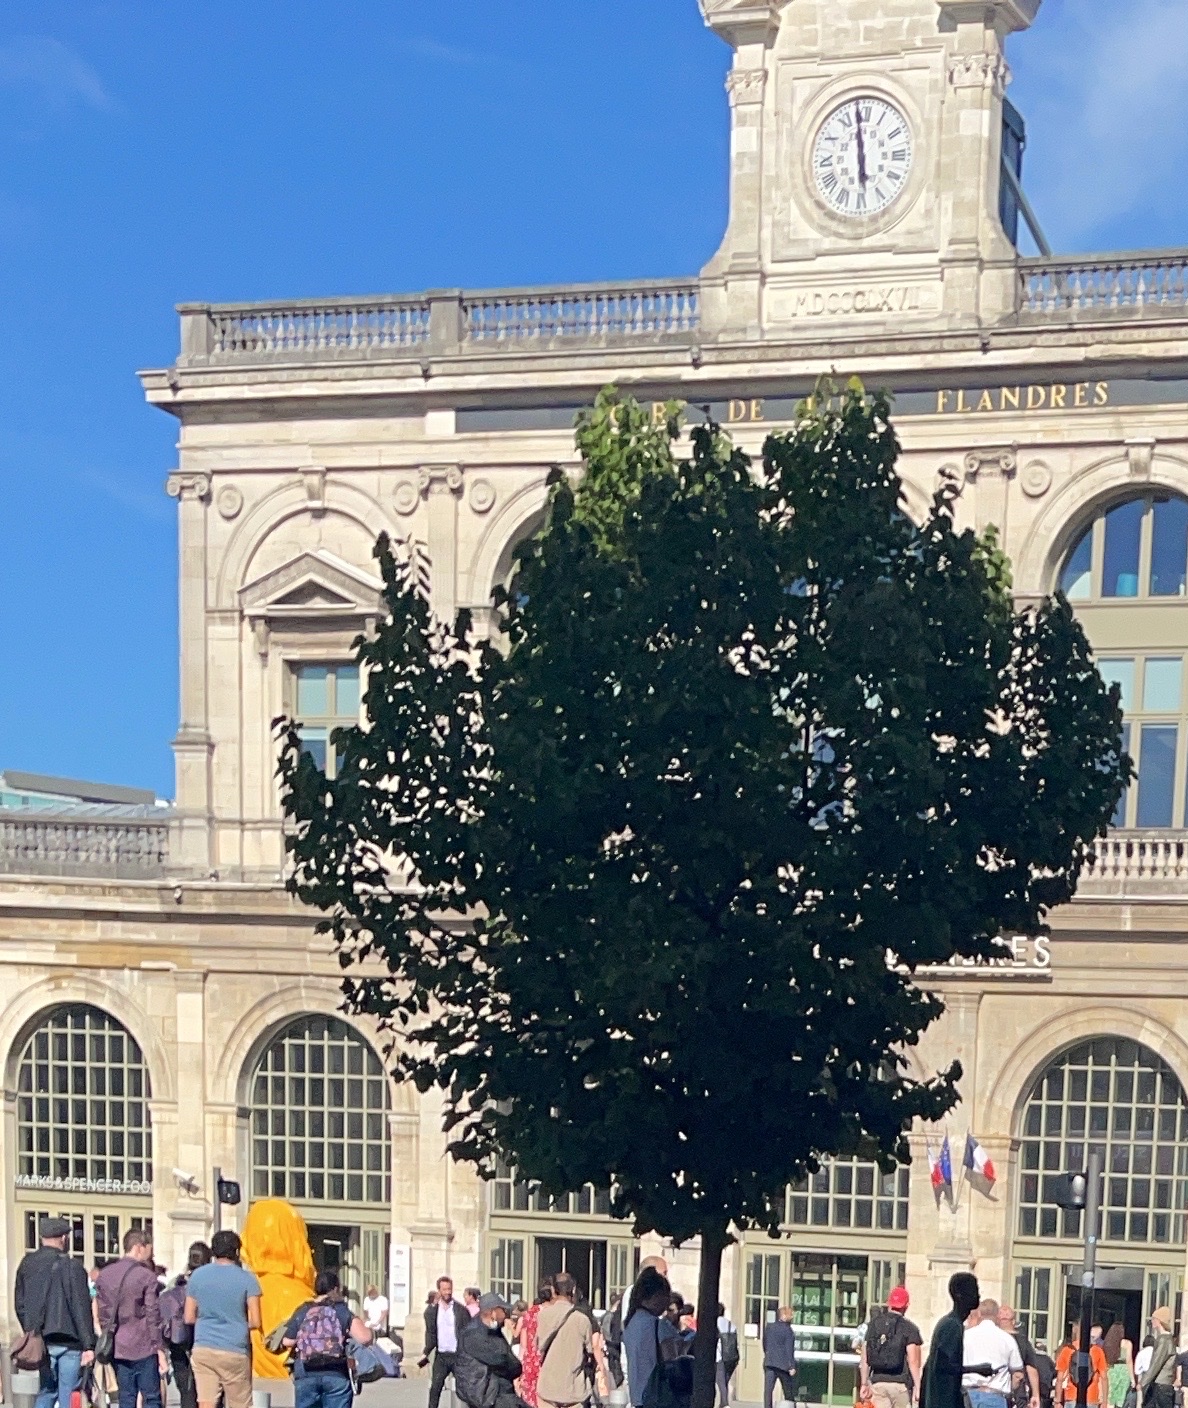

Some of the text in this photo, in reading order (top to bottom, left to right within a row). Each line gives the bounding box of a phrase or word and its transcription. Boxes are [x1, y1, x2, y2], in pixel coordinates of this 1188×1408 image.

[727, 398, 764, 423] DE
[936, 381, 1109, 414] FLANDRES
[123, 1179, 152, 1194] FOO
